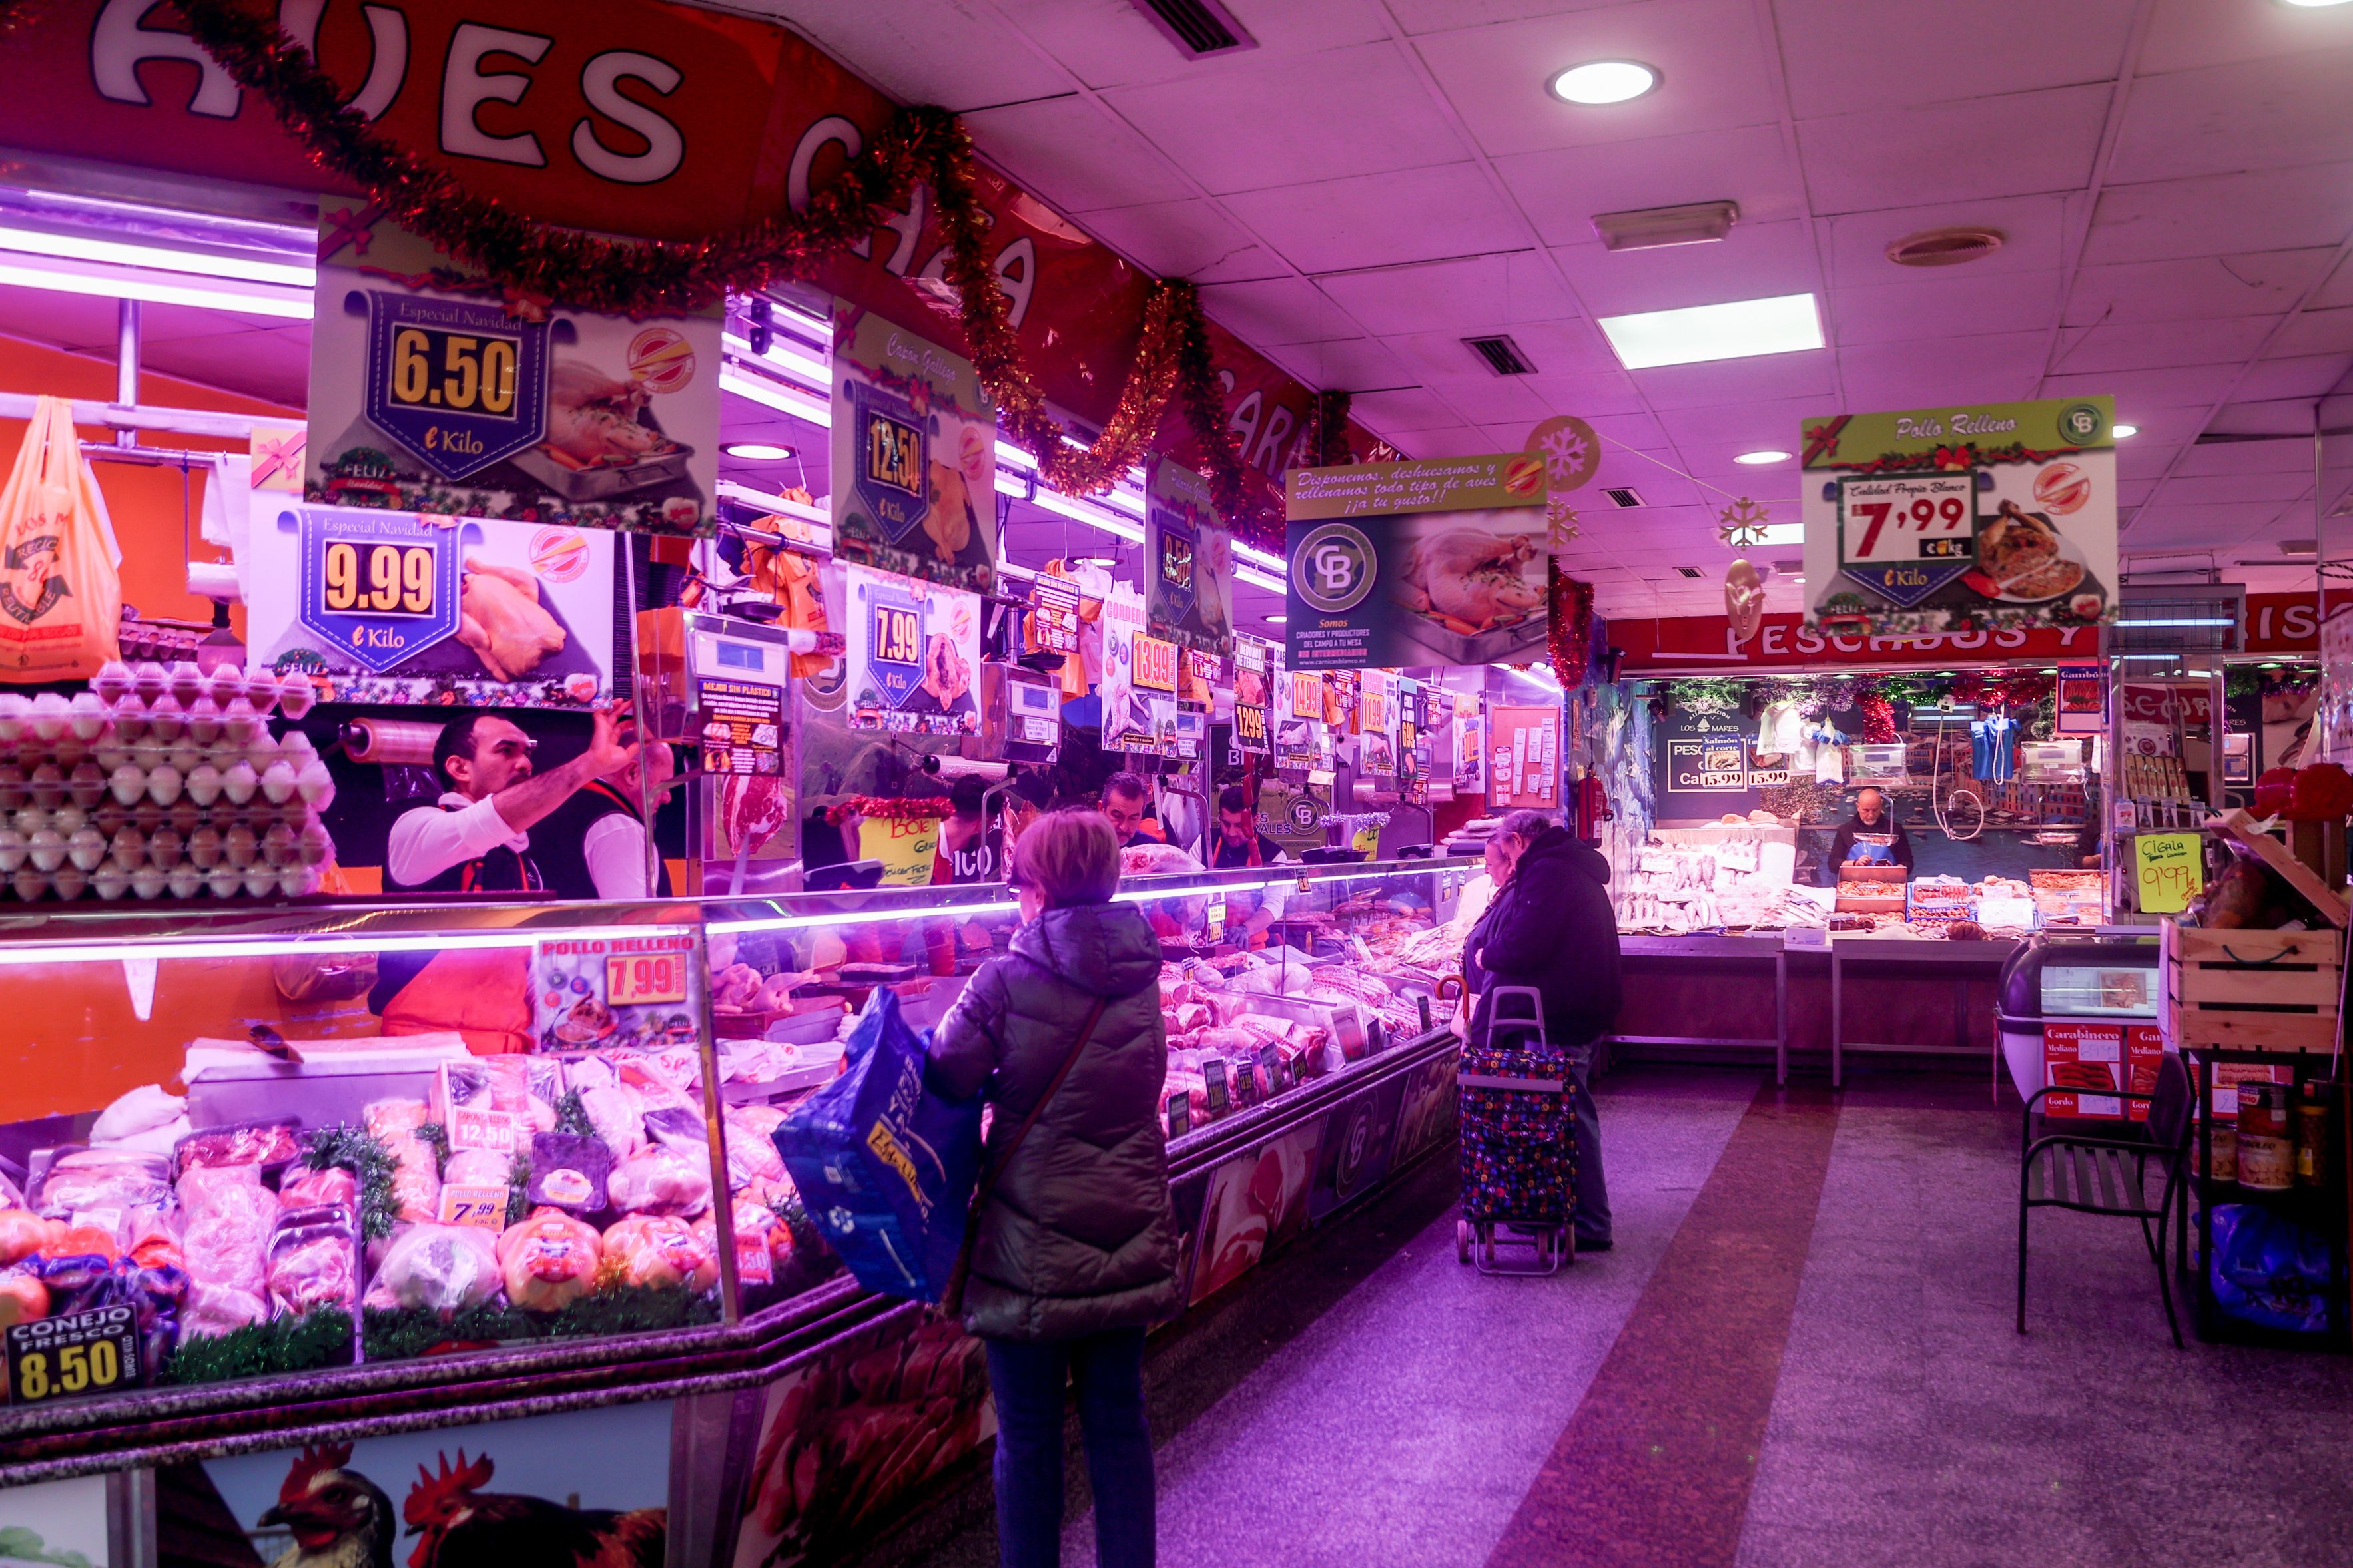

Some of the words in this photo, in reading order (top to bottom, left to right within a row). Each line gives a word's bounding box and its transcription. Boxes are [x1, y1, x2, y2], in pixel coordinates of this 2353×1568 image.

[88, 0, 686, 185] AVES
[400, 302, 460, 324] Especial
[464, 308, 523, 332] Navidad
[394, 330, 515, 413] 6.50
[1895, 416, 1943, 440] Pollo
[1950, 413, 2017, 437] Relleno
[442, 430, 484, 455] Kilo
[1391, 464, 1481, 480] deshuesamos
[1487, 463, 1496, 477] y
[1295, 484, 1368, 500] rellenamos
[1374, 482, 1403, 495] todo
[1409, 479, 1438, 493] tipo
[1444, 476, 1459, 489] de
[1465, 475, 1496, 487] aves
[1849, 482, 1891, 497] Calidad
[1895, 483, 1927, 498] Propia
[1930, 481, 1965, 493] Blanco
[1373, 497, 1388, 508] tu
[1395, 489, 1447, 510] gusto!!
[886, 499, 906, 523] Kilo
[322, 517, 376, 536] Especial
[379, 521, 433, 538] Navidad
[326, 543, 433, 613] 9.99
[1897, 568, 1928, 587] Kilo
[1319, 619, 1348, 628] Somos
[1331, 629, 1370, 637] PRODUCTORES
[368, 627, 405, 649] Kilo
[878, 609, 918, 662] 7.99
[1239, 643, 1262, 660] REDONDO
[1134, 639, 1170, 685] 13,99
[1236, 654, 1243, 666] DE
[1244, 657, 1264, 672] TERNERA
[703, 682, 727, 692] MEJOR
[729, 684, 741, 693] SIN
[741, 686, 771, 697] PLÁSTICO
[892, 674, 906, 689] Kilo
[1704, 773, 1742, 786] 15.99
[1750, 772, 1788, 786] 15.99
[542, 942, 605, 956] POLLO
[611, 937, 695, 951] RELLENO
[610, 958, 674, 999] 7,99
[2047, 1029, 2119, 1040] Carabinero
[2047, 1044, 2077, 1053] Mediano
[2131, 1047, 2161, 1055] Mediano
[2048, 1097, 2073, 1106] Gordo
[460, 1124, 511, 1143] 12.50
[451, 1190, 472, 1198] POLLO
[474, 1190, 504, 1198] RELLENO
[12, 1308, 131, 1340] CONEJO
[20, 1324, 125, 1352] FRESCO
[121, 1334, 134, 1353] KILO
[20, 1340, 118, 1400] 8.50
[123, 1354, 137, 1380] EUROS
